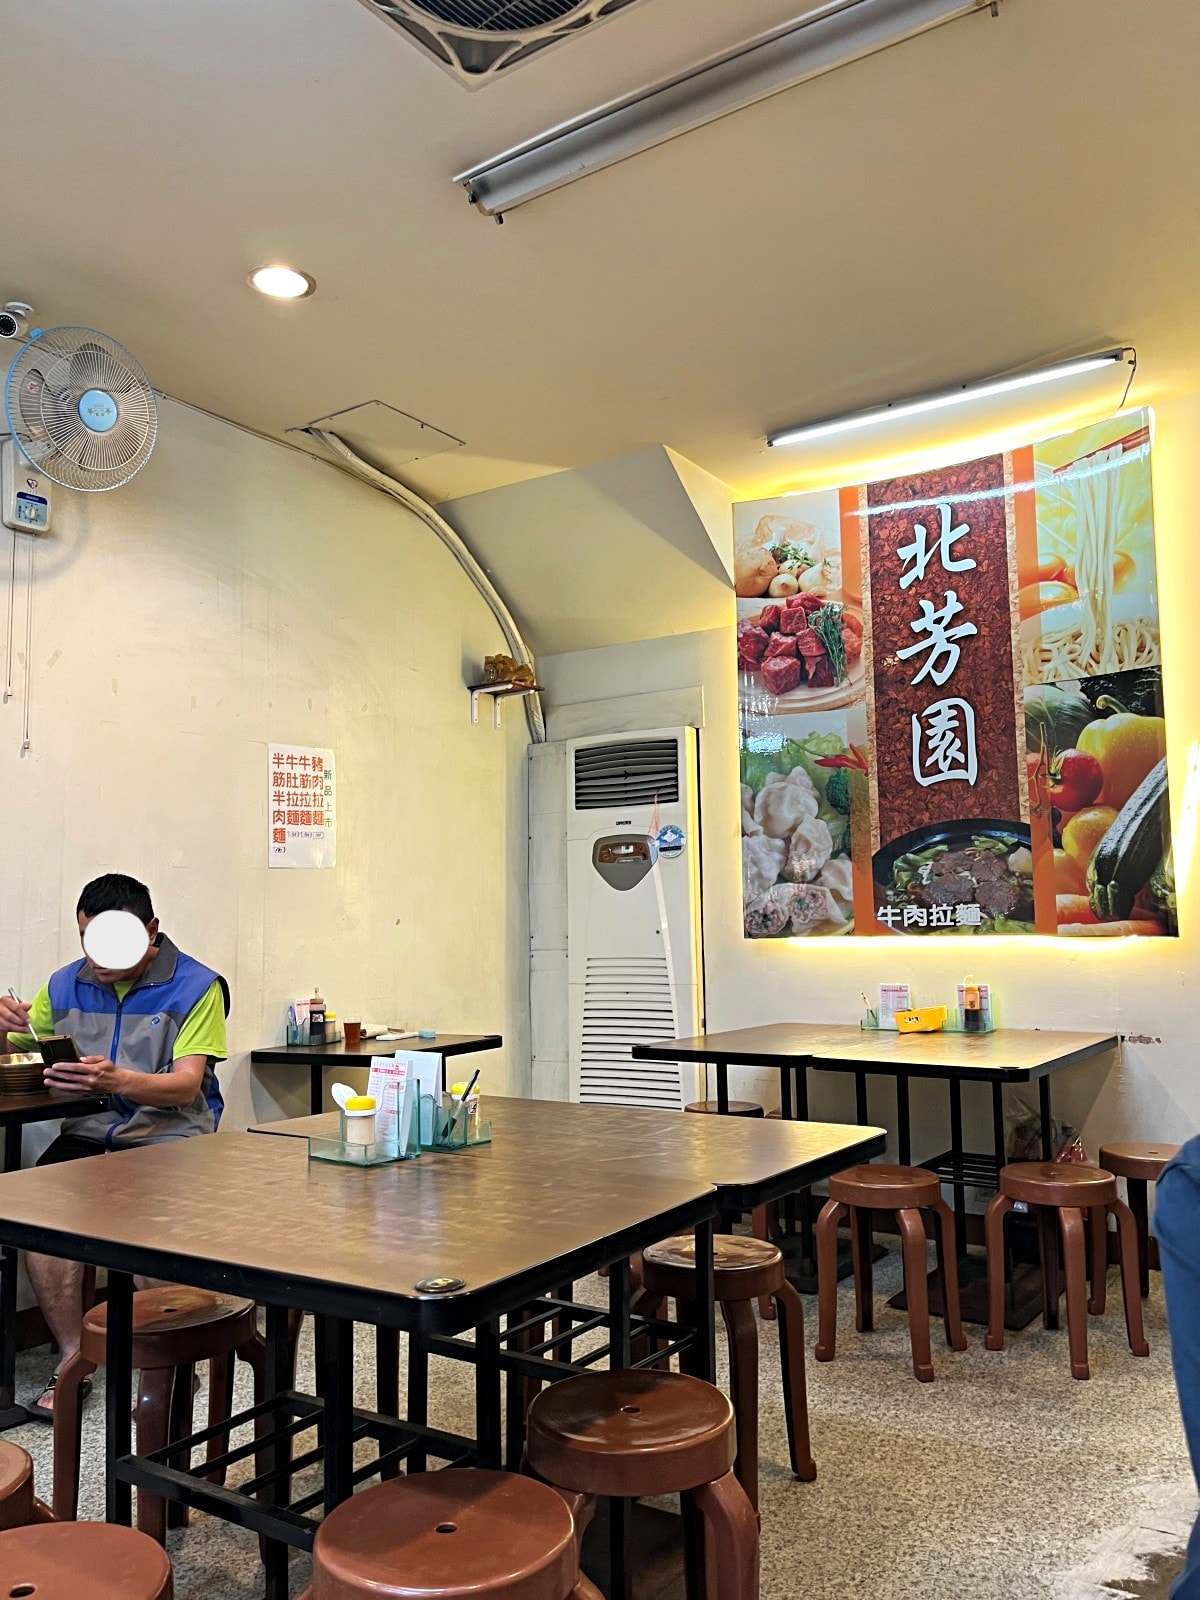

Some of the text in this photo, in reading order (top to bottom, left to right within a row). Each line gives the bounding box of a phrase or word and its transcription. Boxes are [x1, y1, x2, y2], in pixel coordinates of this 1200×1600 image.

[896, 502, 978, 787] 北芳園
[272, 752, 286, 844] 半筋半肉麵
[286, 754, 299, 826] 牛肚拉麵
[299, 755, 312, 826] 牛筋拉麵
[323, 769, 333, 828] 新品上市
[877, 903, 982, 927] 牛肉拉麵
